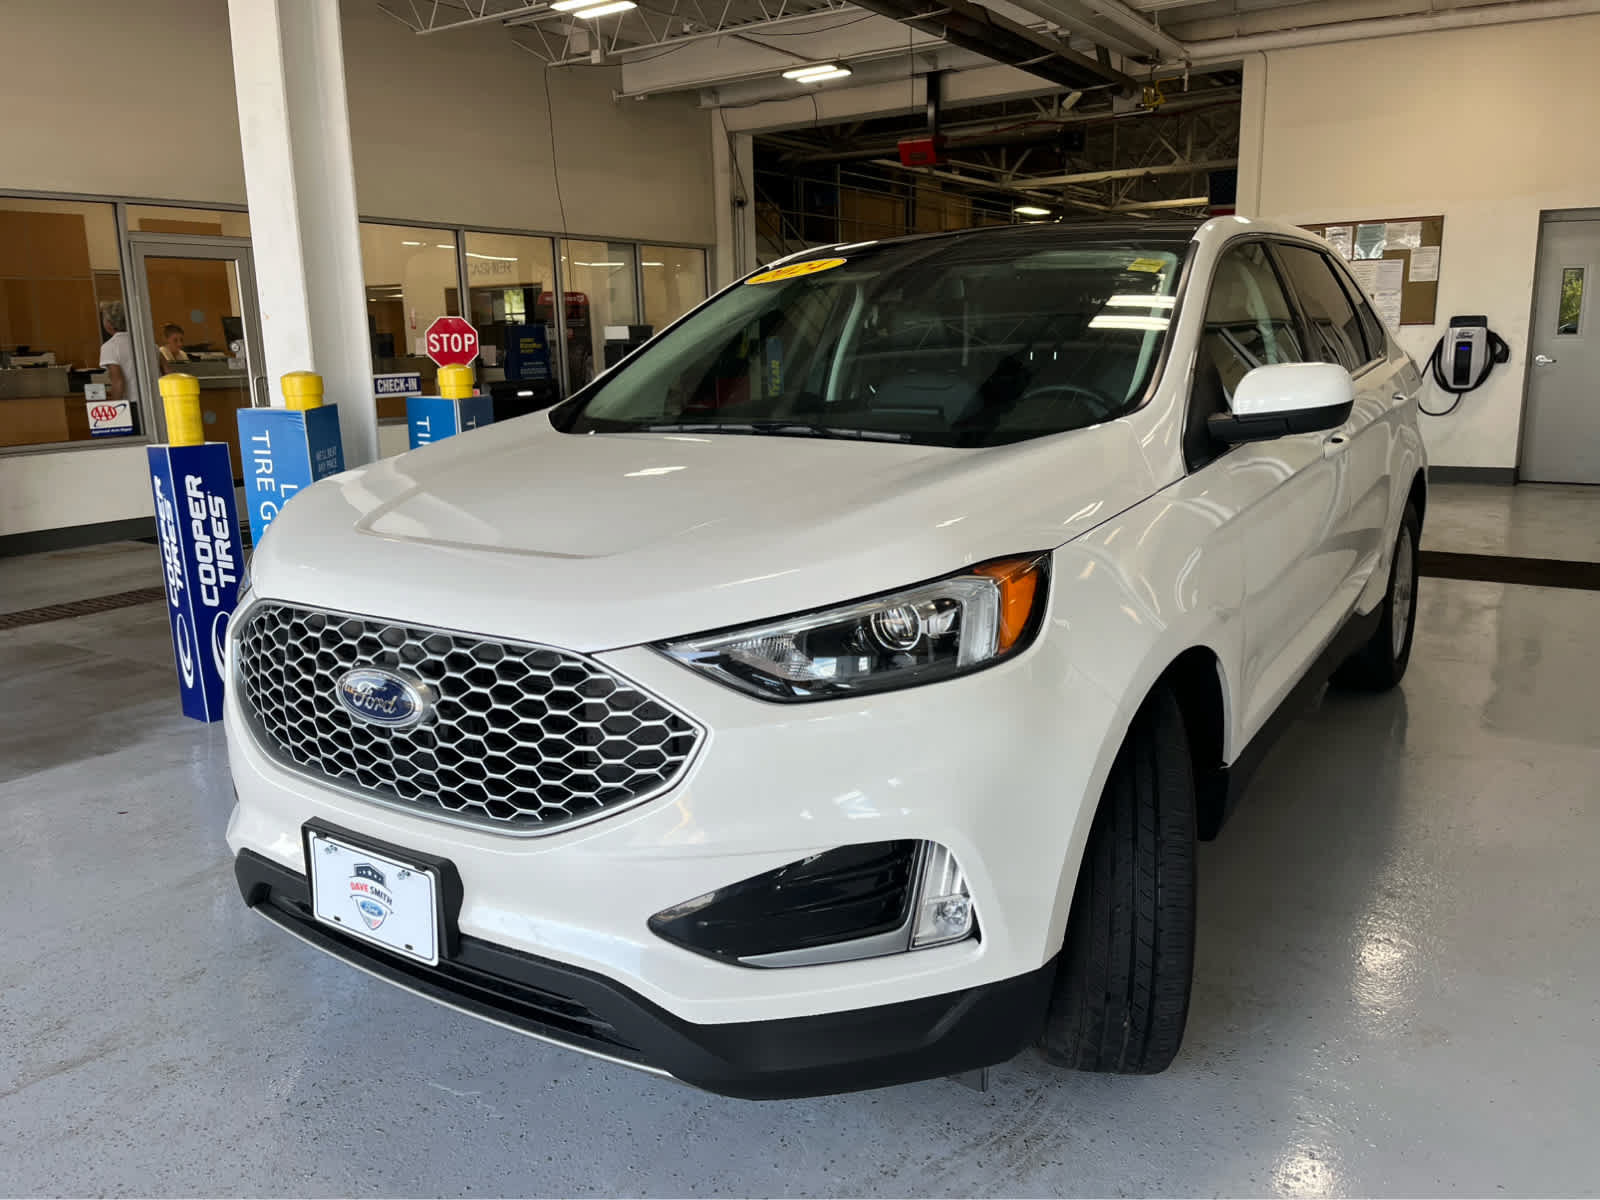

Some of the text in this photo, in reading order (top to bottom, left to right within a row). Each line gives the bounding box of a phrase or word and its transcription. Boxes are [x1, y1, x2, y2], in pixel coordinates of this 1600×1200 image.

[428, 333, 475, 353] STOP
[377, 378, 418, 393] CHECK-IN
[91, 404, 117, 421] AAA
[252, 430, 276, 492] TIRE
[184, 474, 220, 607] COOPER
[207, 495, 236, 588] TIRES
[352, 681, 398, 714] Ford
[350, 881, 393, 906] DAVE SMITH
